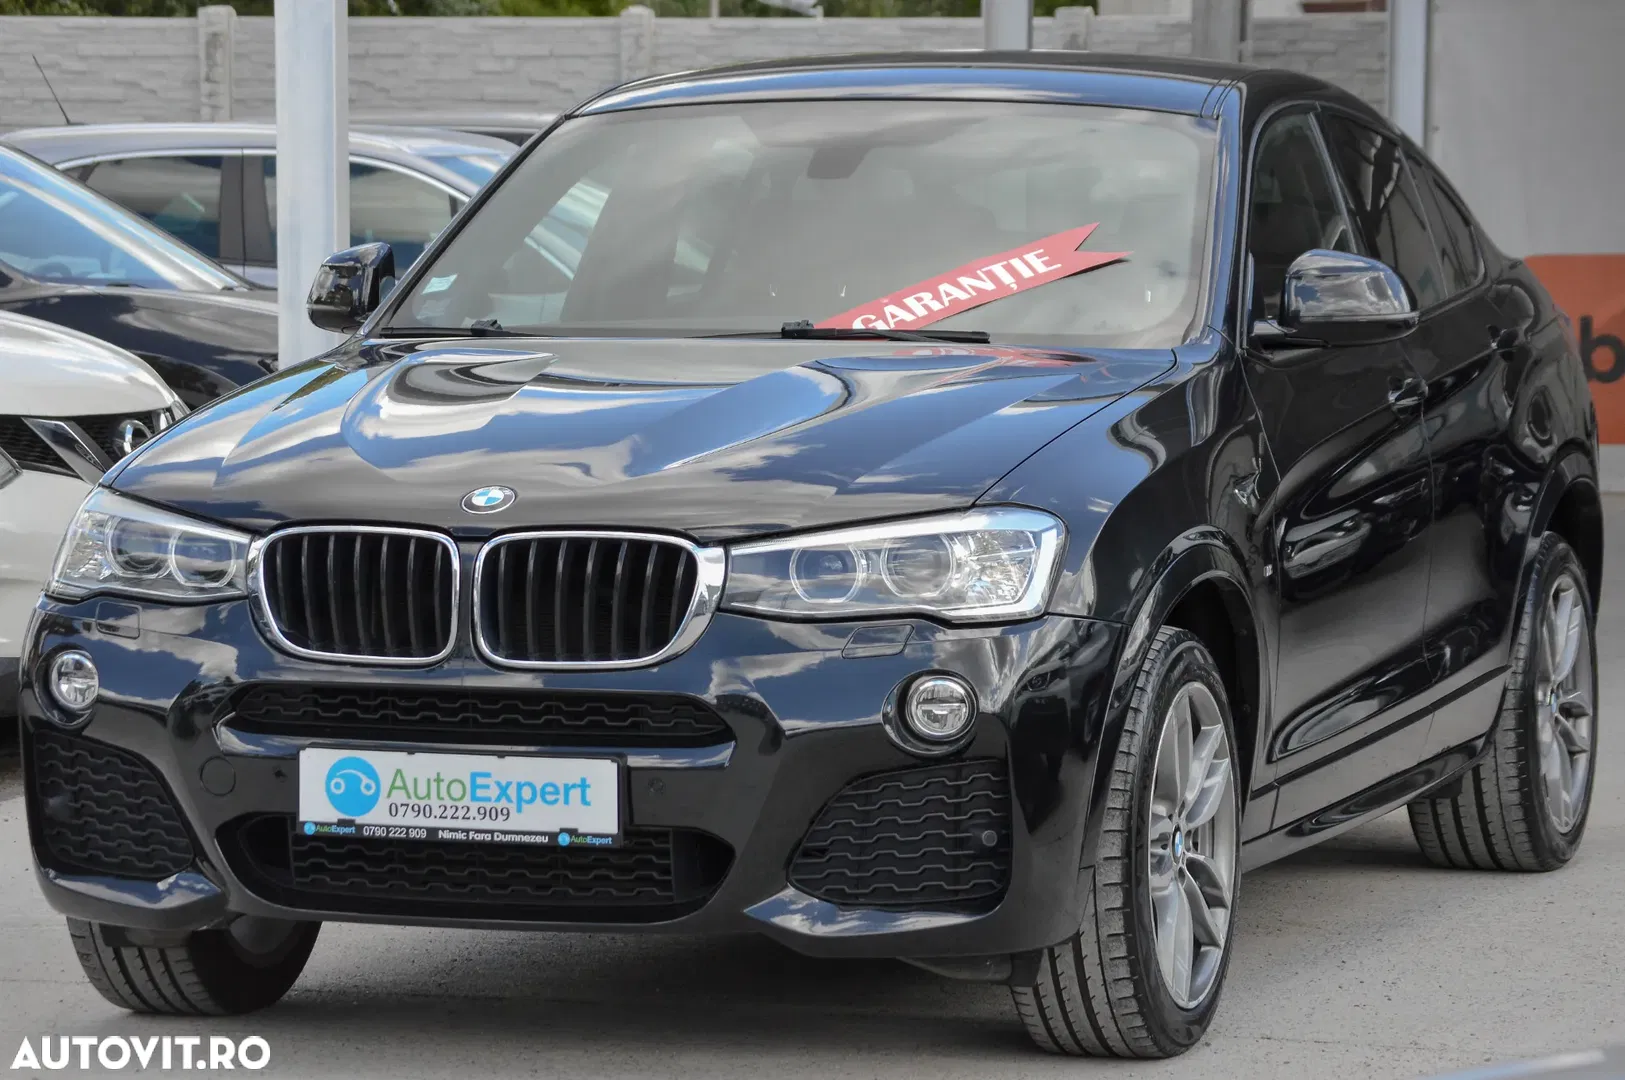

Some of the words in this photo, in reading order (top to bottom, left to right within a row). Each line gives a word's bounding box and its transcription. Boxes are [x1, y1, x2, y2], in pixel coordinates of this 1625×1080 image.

[852, 249, 1062, 330] GARANȚIE
[387, 769, 592, 813] AutoExpert
[388, 802, 511, 821] 0790.222.909
[315, 824, 356, 834] AutoExpert
[363, 825, 387, 836] 0790
[388, 826, 407, 837] 222
[408, 827, 427, 838] 909
[438, 829, 467, 840] Nimic
[469, 831, 492, 841] Fara
[494, 833, 549, 843] Dumnezeu
[570, 834, 612, 845] AutoExpert
